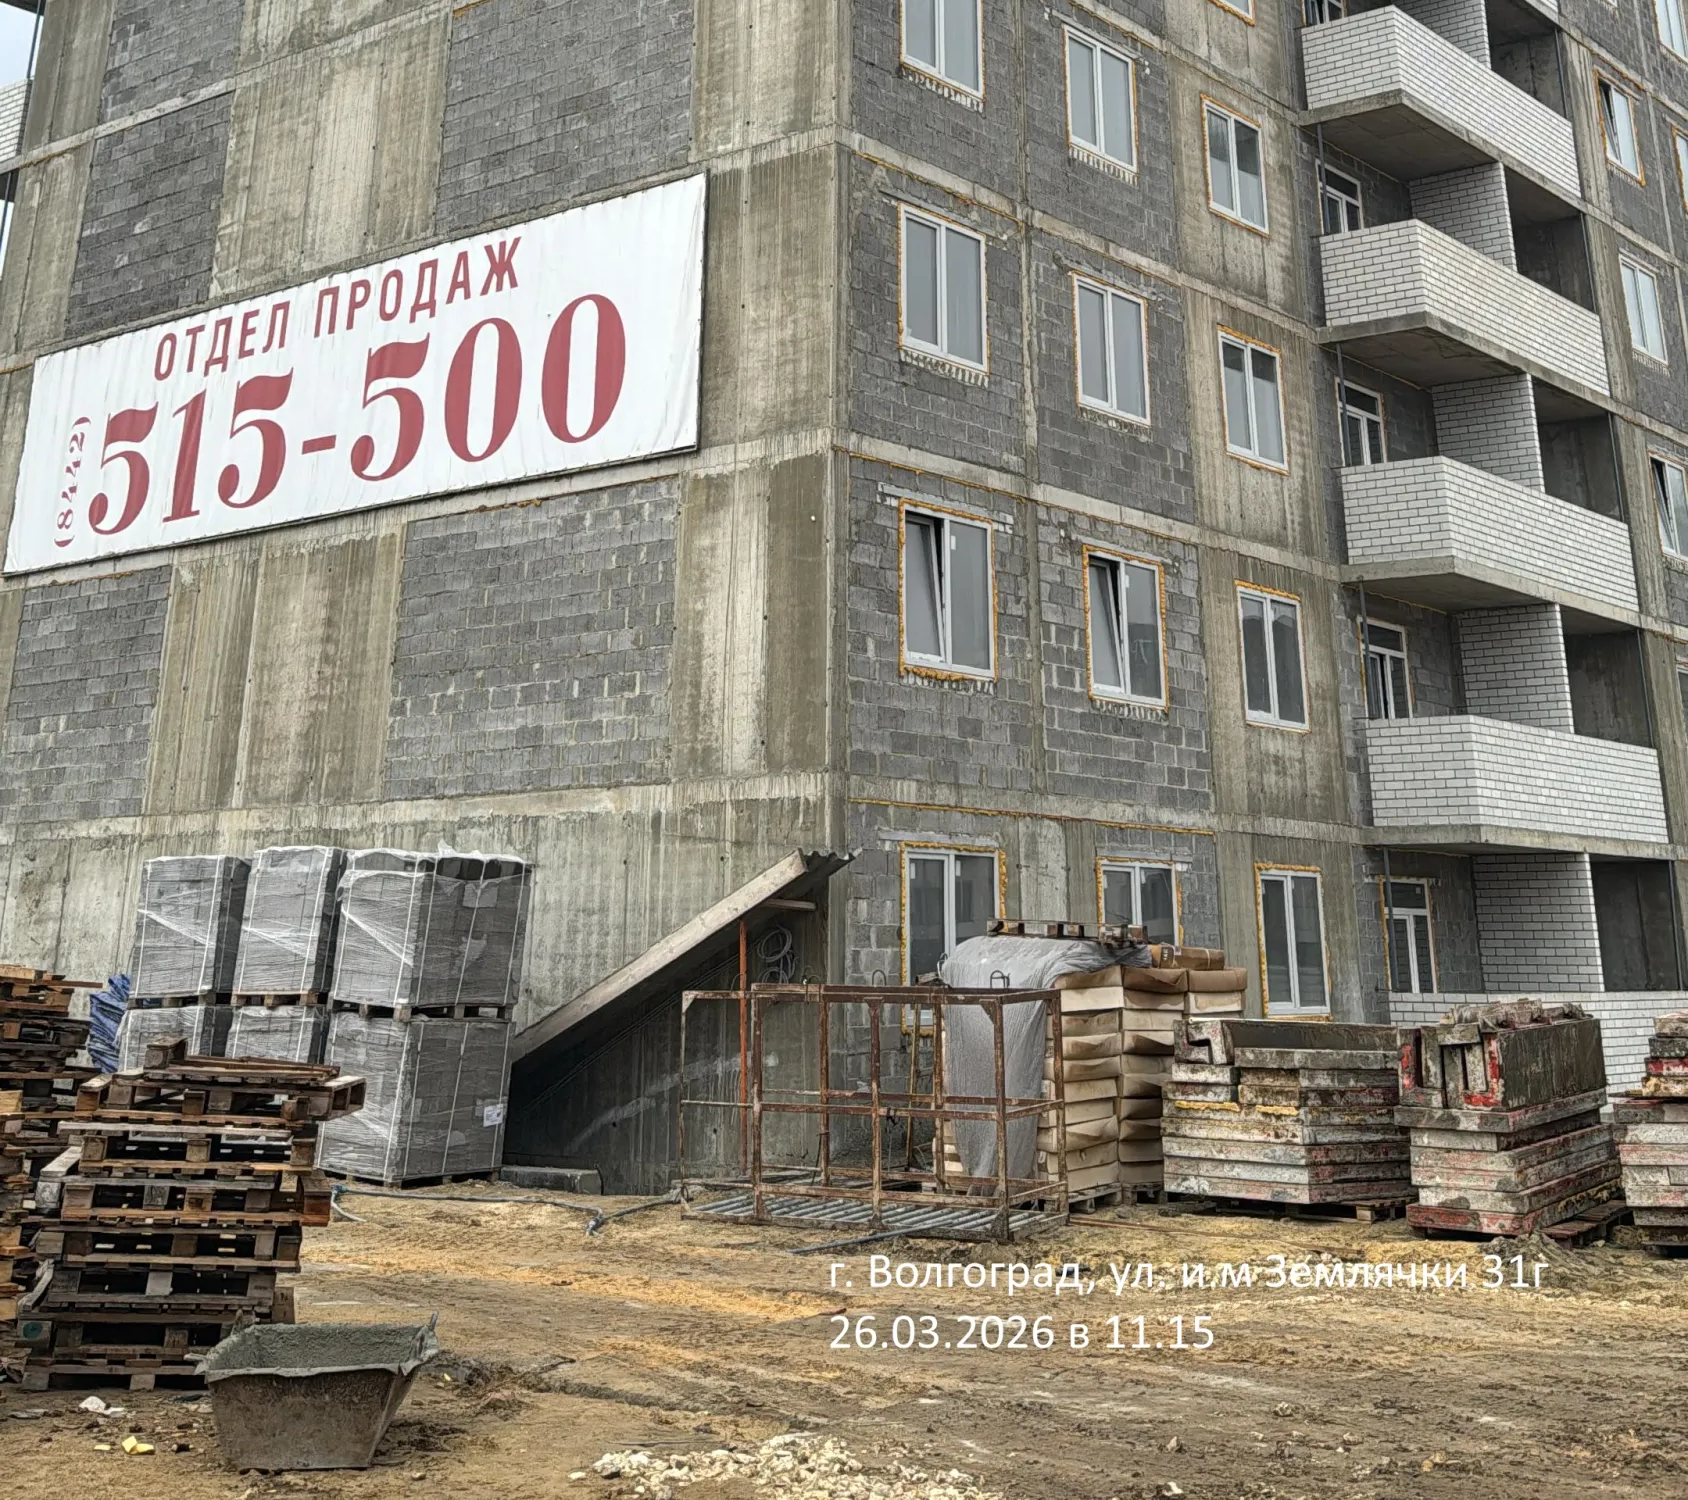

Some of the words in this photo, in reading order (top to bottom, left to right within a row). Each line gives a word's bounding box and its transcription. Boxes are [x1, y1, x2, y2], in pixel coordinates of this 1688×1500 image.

[153, 300, 291, 381] ОТДЕЛ
[313, 236, 522, 338] ПРОДАЖ
[53, 416, 92, 548] (8442)
[87, 293, 628, 536] 515-500
